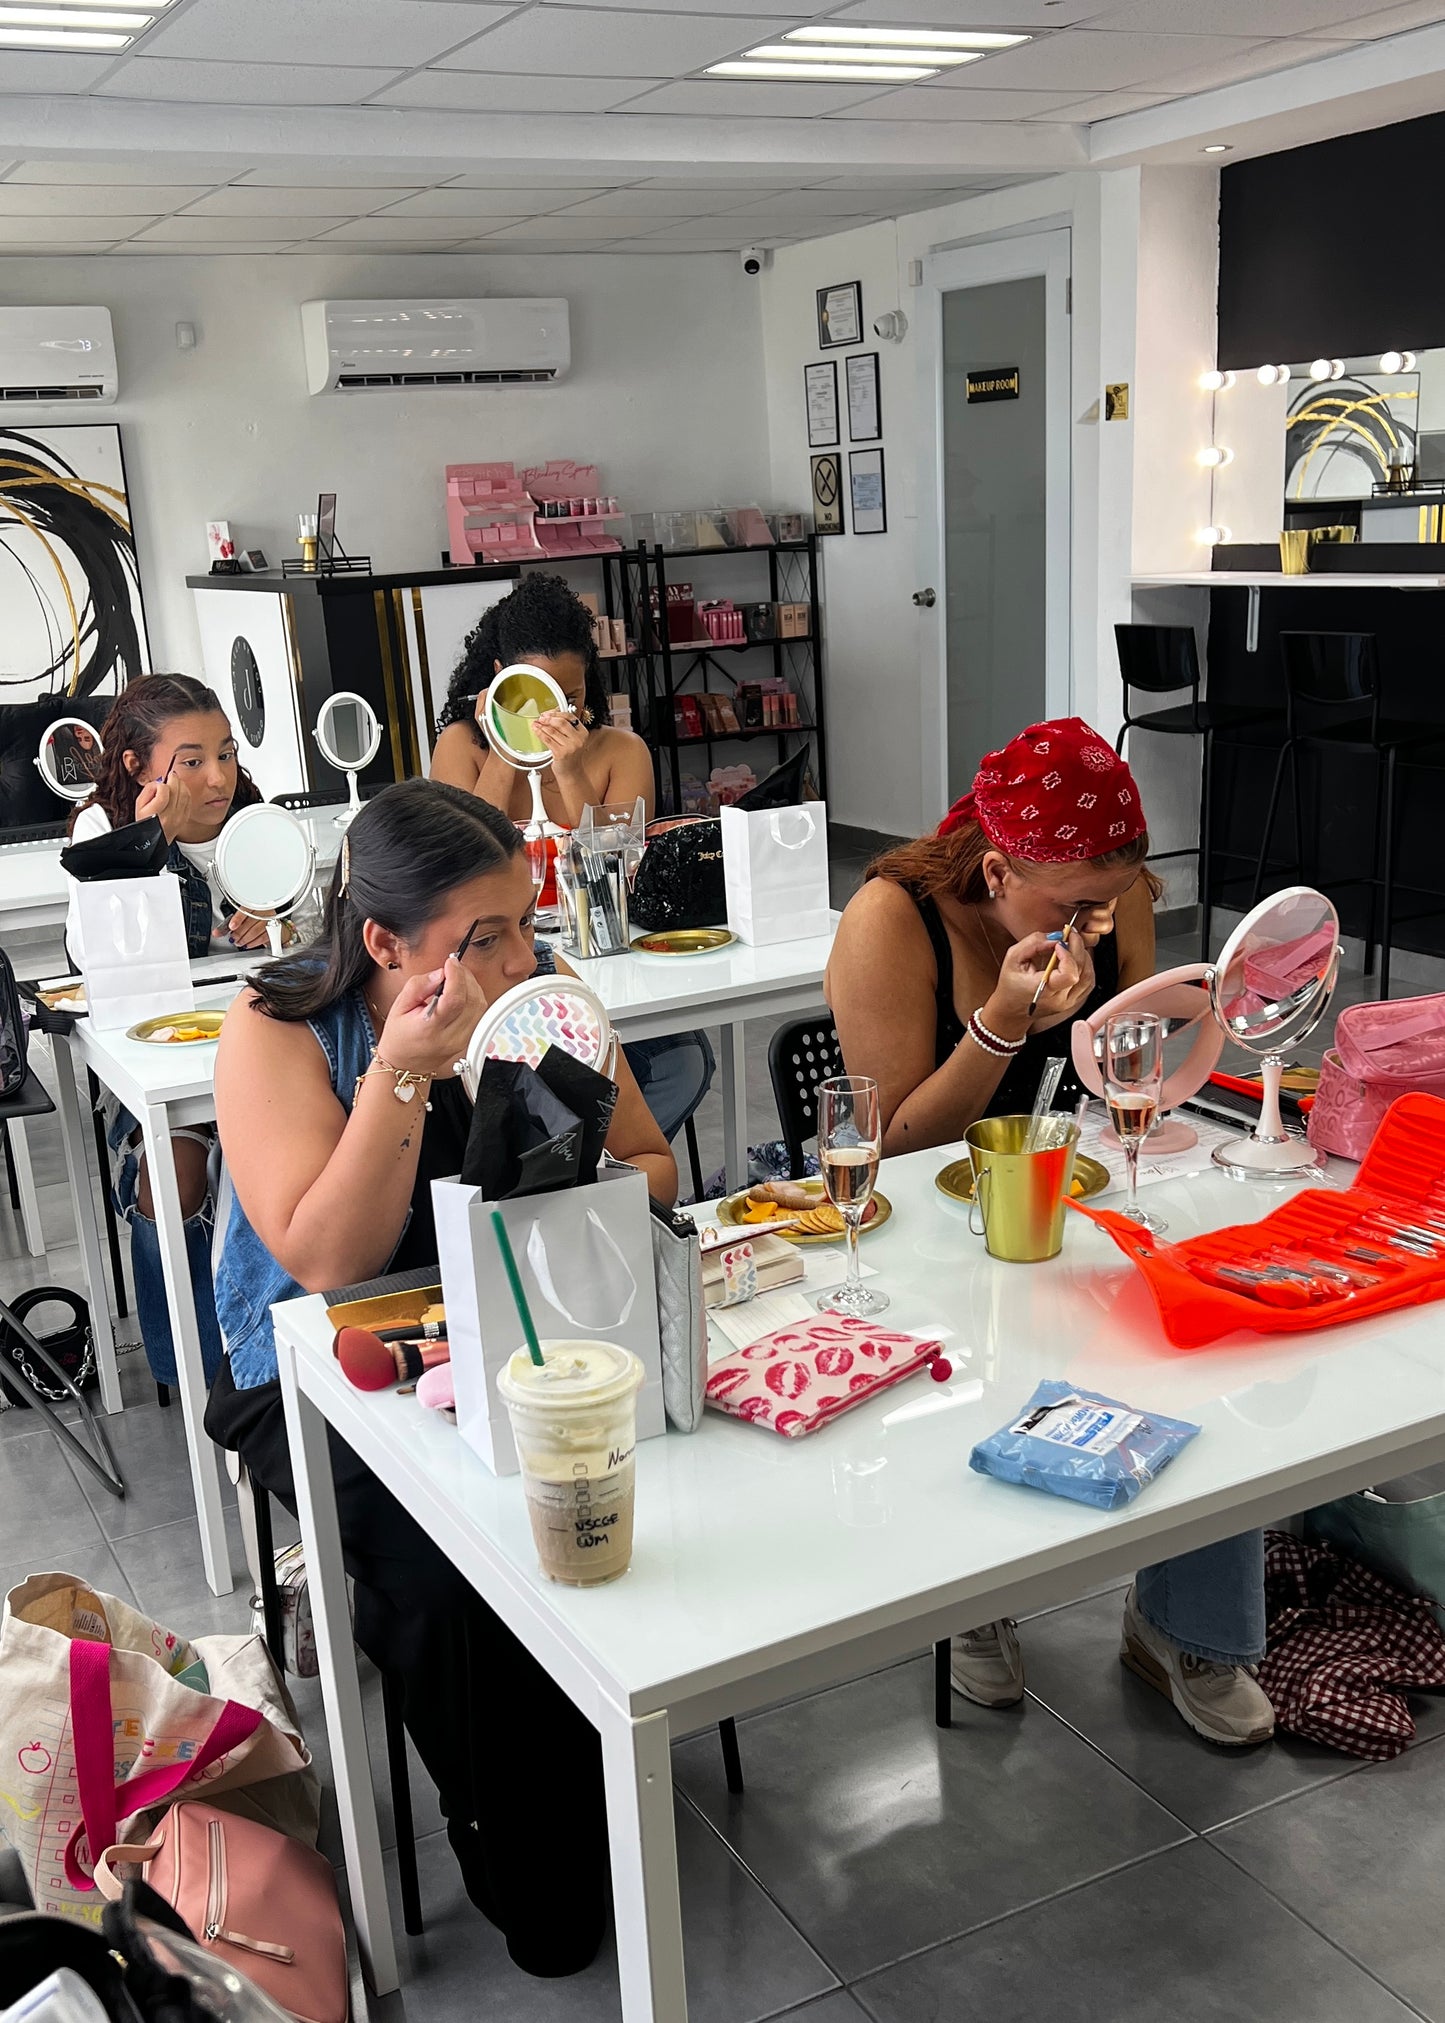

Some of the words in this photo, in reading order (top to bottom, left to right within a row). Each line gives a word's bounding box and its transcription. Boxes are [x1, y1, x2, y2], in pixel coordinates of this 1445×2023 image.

[78, 339, 92, 351] 73
[968, 379, 995, 393] MAKEUP
[995, 377, 1016, 391] ROOM
[824, 512, 833, 521] NO
